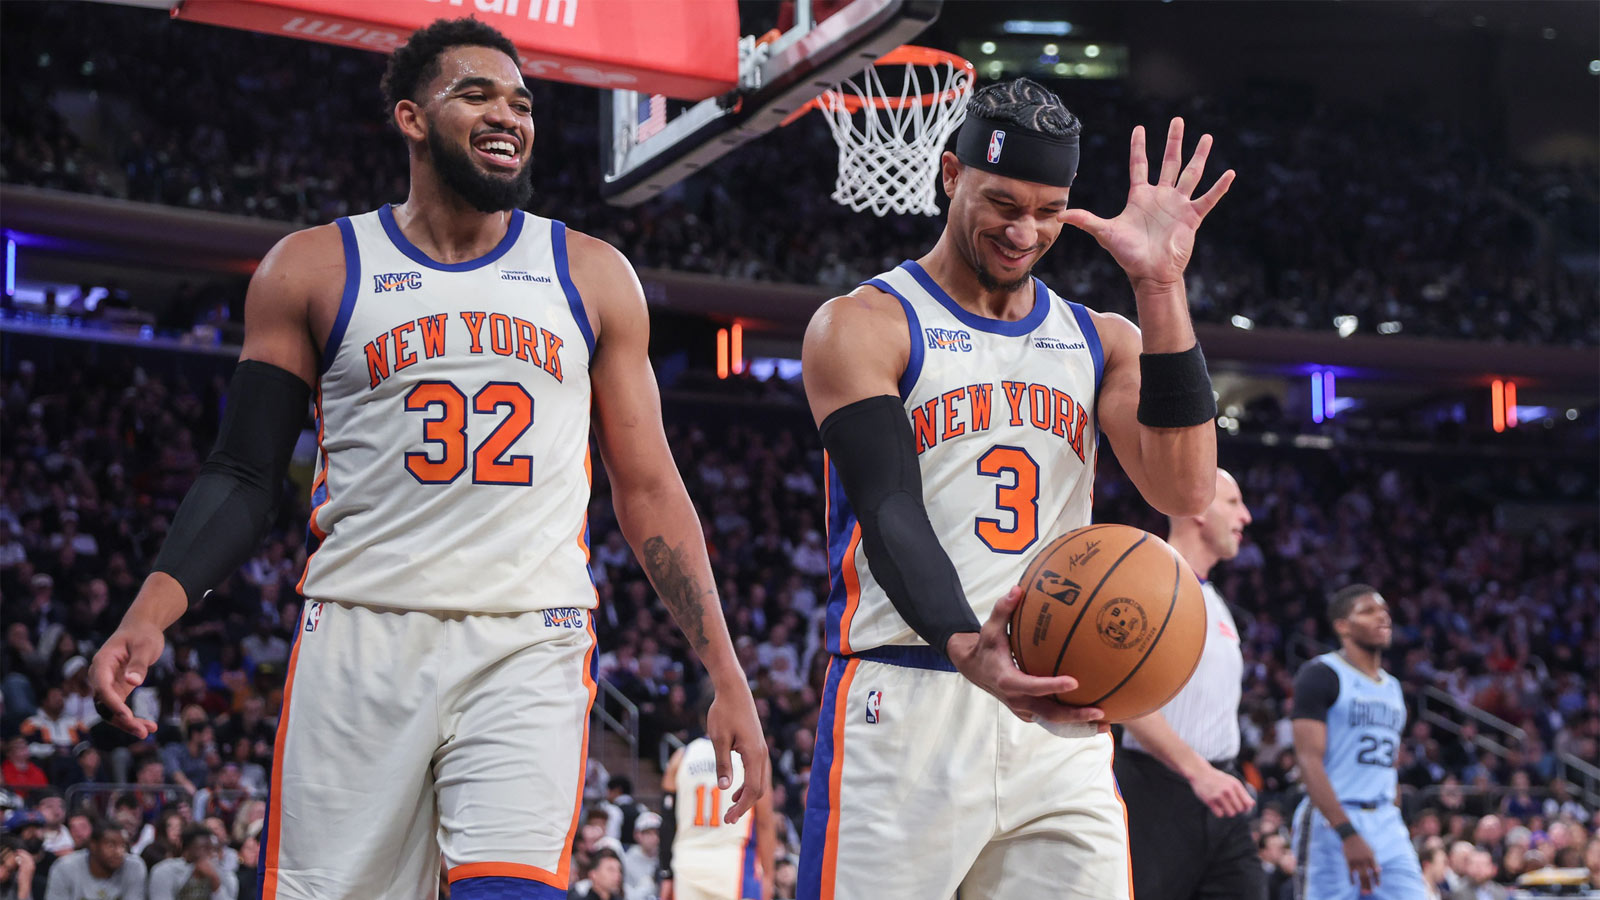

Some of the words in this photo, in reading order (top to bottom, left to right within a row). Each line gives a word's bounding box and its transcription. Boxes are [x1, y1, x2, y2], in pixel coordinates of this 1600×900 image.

[282, 17, 410, 50] arm
[374, 271, 422, 293] NYC
[522, 275, 551, 283] dhabi
[364, 313, 448, 391] NEW
[460, 311, 564, 384] YORK
[925, 328, 973, 352] NYC
[1035, 341, 1054, 349] abu
[1055, 342, 1085, 350] dhabi
[404, 380, 535, 487] 32
[911, 383, 993, 456] NEW
[1001, 380, 1088, 464] YORK
[975, 444, 1040, 555] 3
[541, 607, 583, 628] NYC
[1357, 736, 1394, 768] 23
[693, 784, 721, 828] 11
